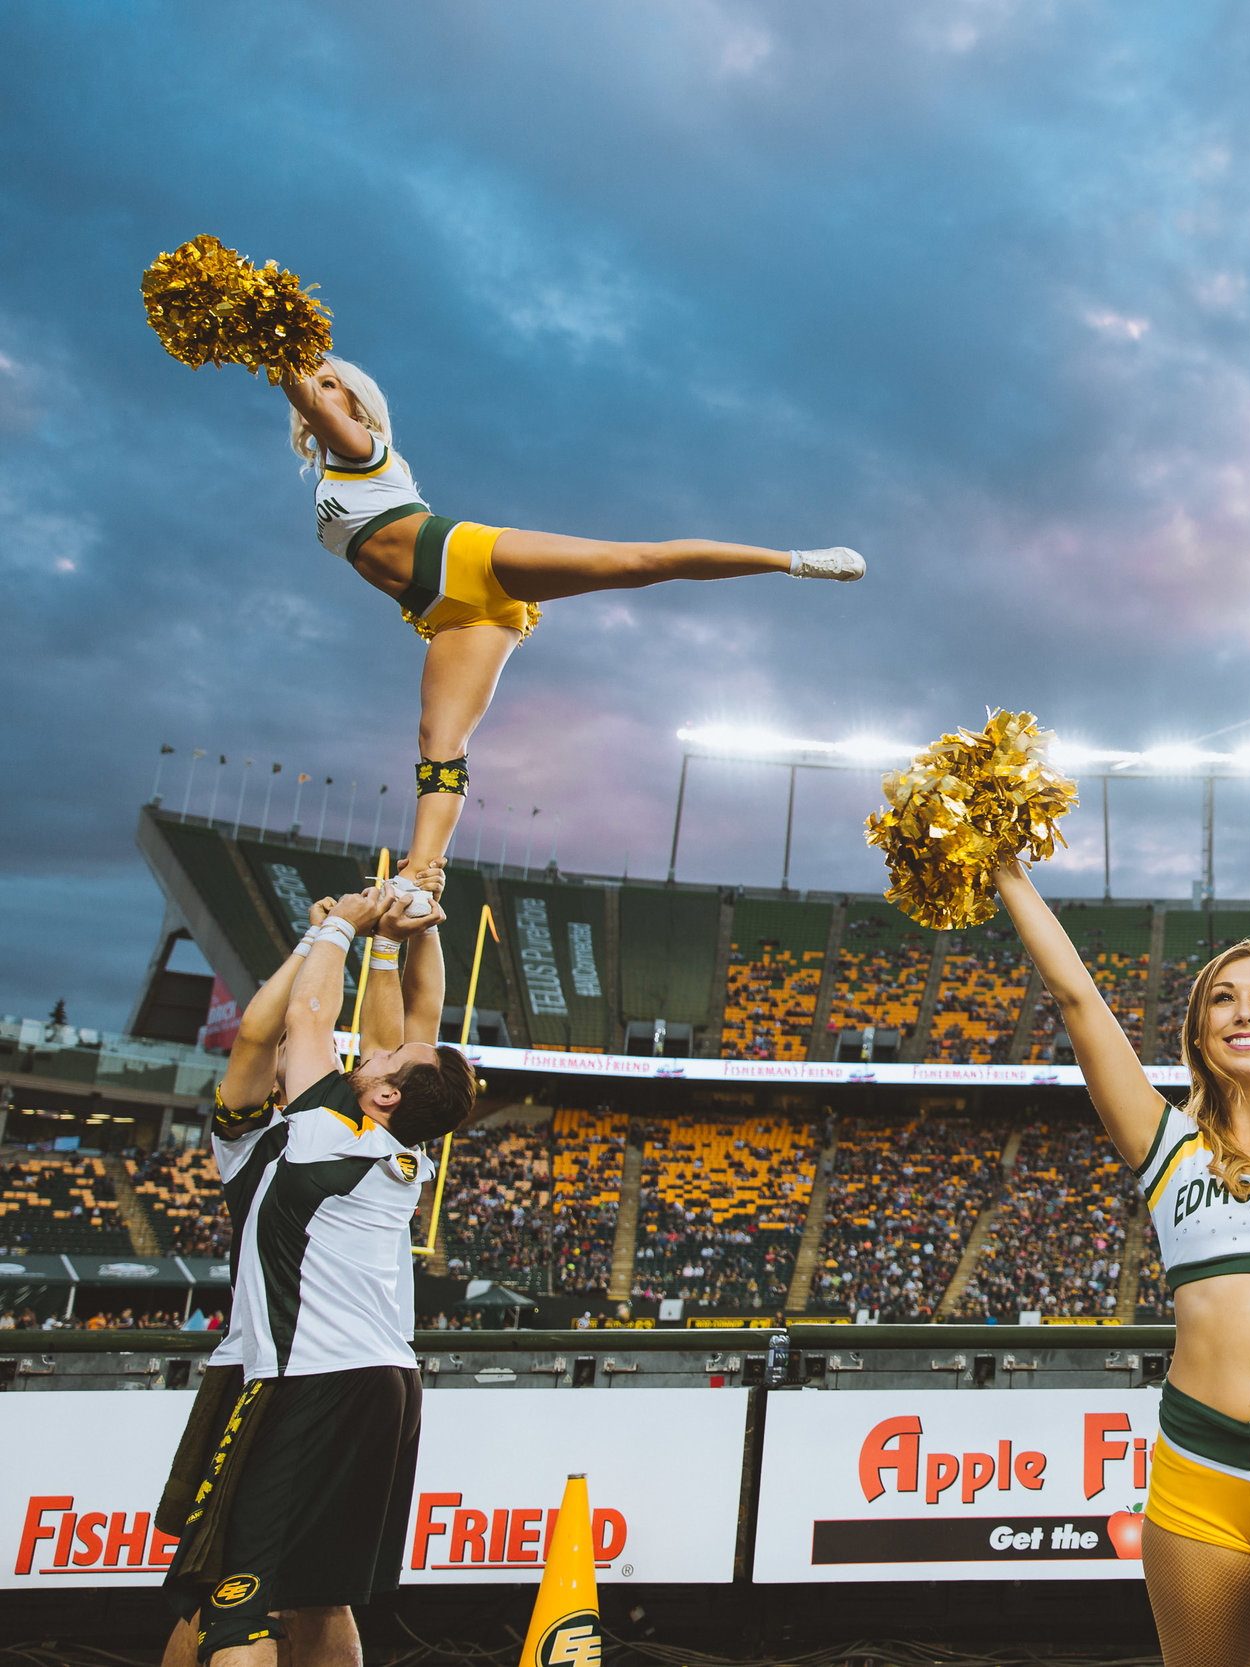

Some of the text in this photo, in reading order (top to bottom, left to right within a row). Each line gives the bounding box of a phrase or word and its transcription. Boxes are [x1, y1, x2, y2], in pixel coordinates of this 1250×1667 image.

[516, 897, 569, 1016] TELUS PureFibre
[859, 1416, 1047, 1505] Apple
[1084, 1413, 1160, 1502] Fi
[989, 1524, 1100, 1552] Get the
